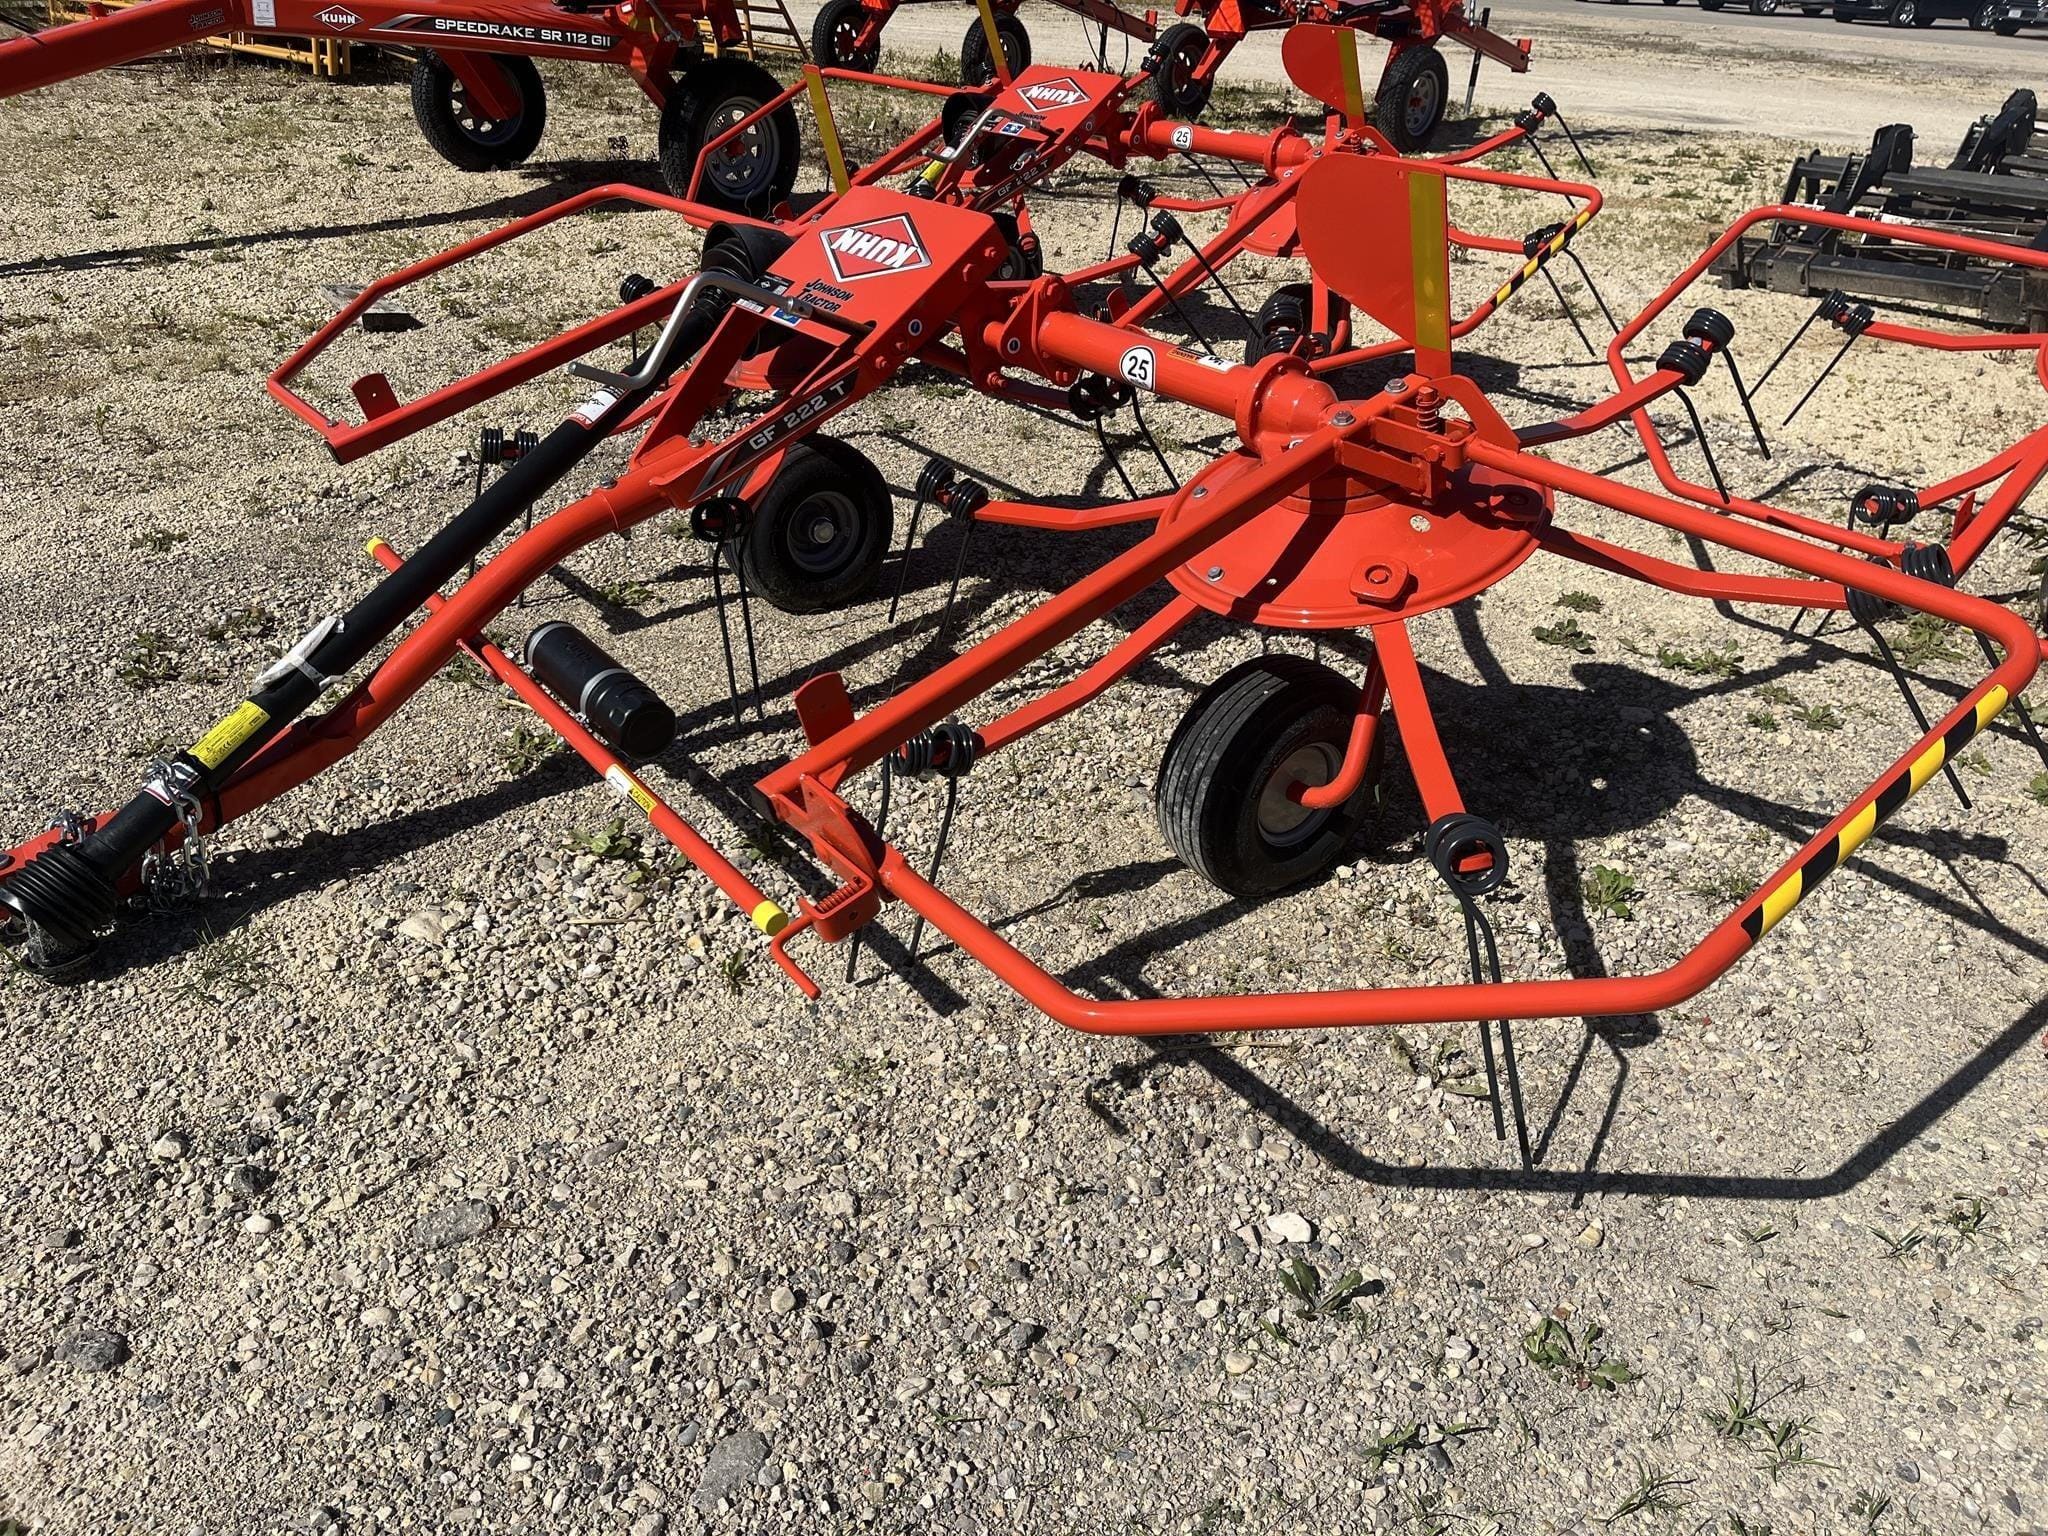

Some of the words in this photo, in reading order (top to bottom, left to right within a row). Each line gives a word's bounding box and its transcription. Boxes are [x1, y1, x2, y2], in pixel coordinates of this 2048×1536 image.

[321, 13, 356, 24] KUHN
[435, 19, 535, 38] SPEEDRAKE
[541, 29, 562, 42] SR
[565, 32, 588, 44] 112
[591, 35, 611, 47] GII
[1025, 85, 1080, 104] KUHN
[1176, 130, 1190, 144] 25
[997, 183, 1012, 197] GF
[1040, 159, 1049, 168] T
[830, 228, 918, 269] KUHN
[797, 288, 842, 313] TRACTOR
[806, 279, 854, 302] JOHNSON
[1127, 355, 1150, 381] 25
[749, 424, 776, 450] GF
[783, 394, 828, 429] 222
[829, 380, 846, 396] T
